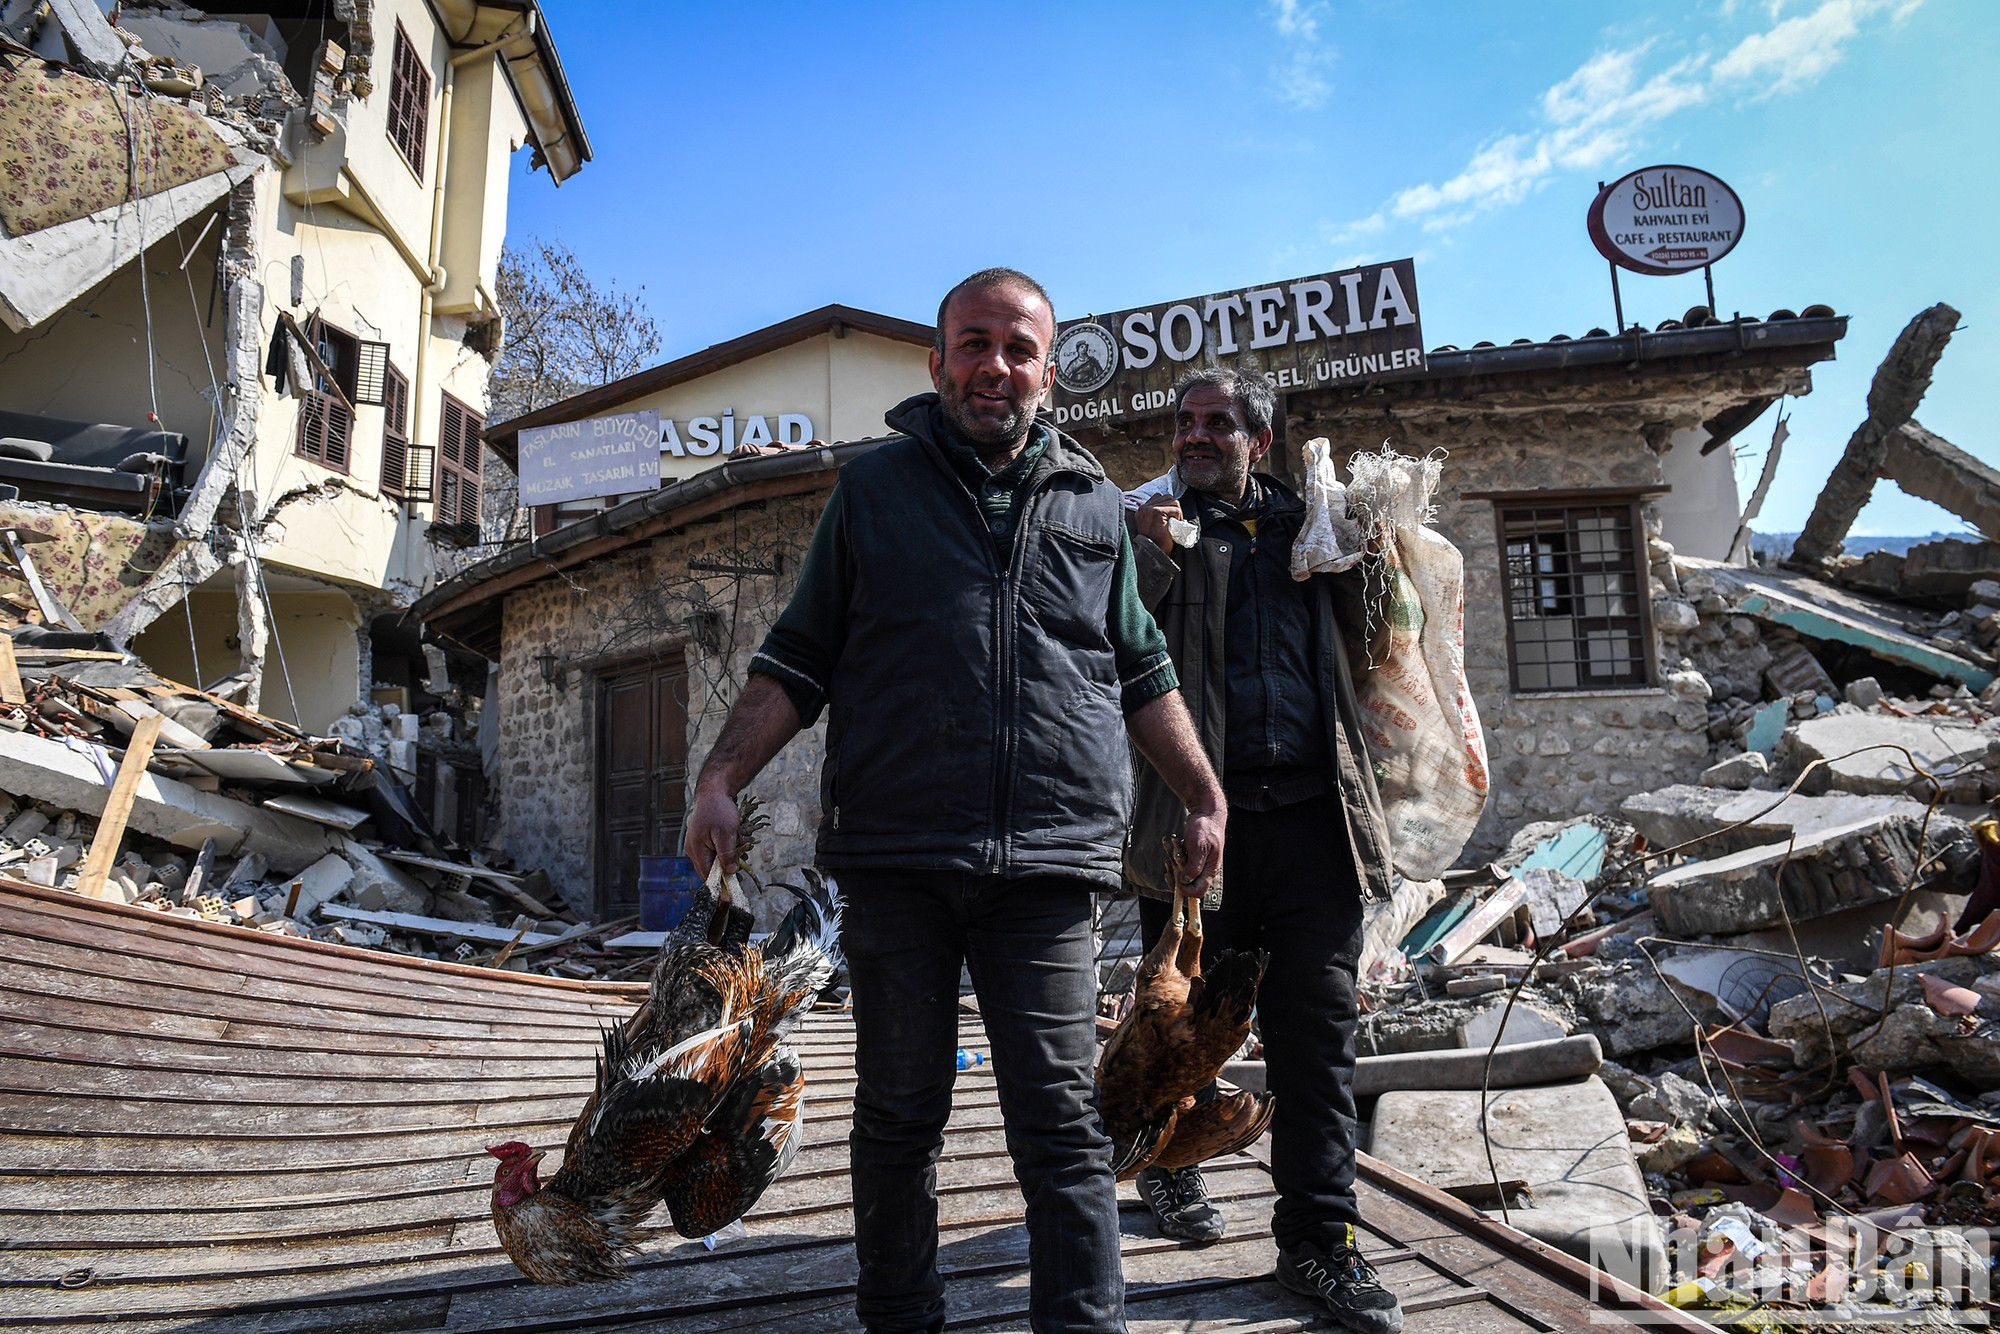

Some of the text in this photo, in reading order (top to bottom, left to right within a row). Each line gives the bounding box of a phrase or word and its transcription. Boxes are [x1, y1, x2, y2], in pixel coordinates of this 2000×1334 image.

[1633, 171, 1706, 211] Sultan
[1634, 210, 1709, 226] KAHVALTI EVİ
[1615, 233, 1645, 245] CAFE
[1658, 231, 1732, 244] RESTAURANT
[1121, 267, 1416, 370] SOTERIA
[1056, 397, 1123, 424] DOĞAL
[1131, 388, 1177, 412] GIDA
[1315, 347, 1422, 381] ÜRÜNLER
[520, 417, 658, 460] TAŞLARIN BÜYÜSÜ
[543, 441, 636, 468] EL SANATLARI
[582, 465, 635, 485] TASARIM
[639, 457, 658, 476] EVİ
